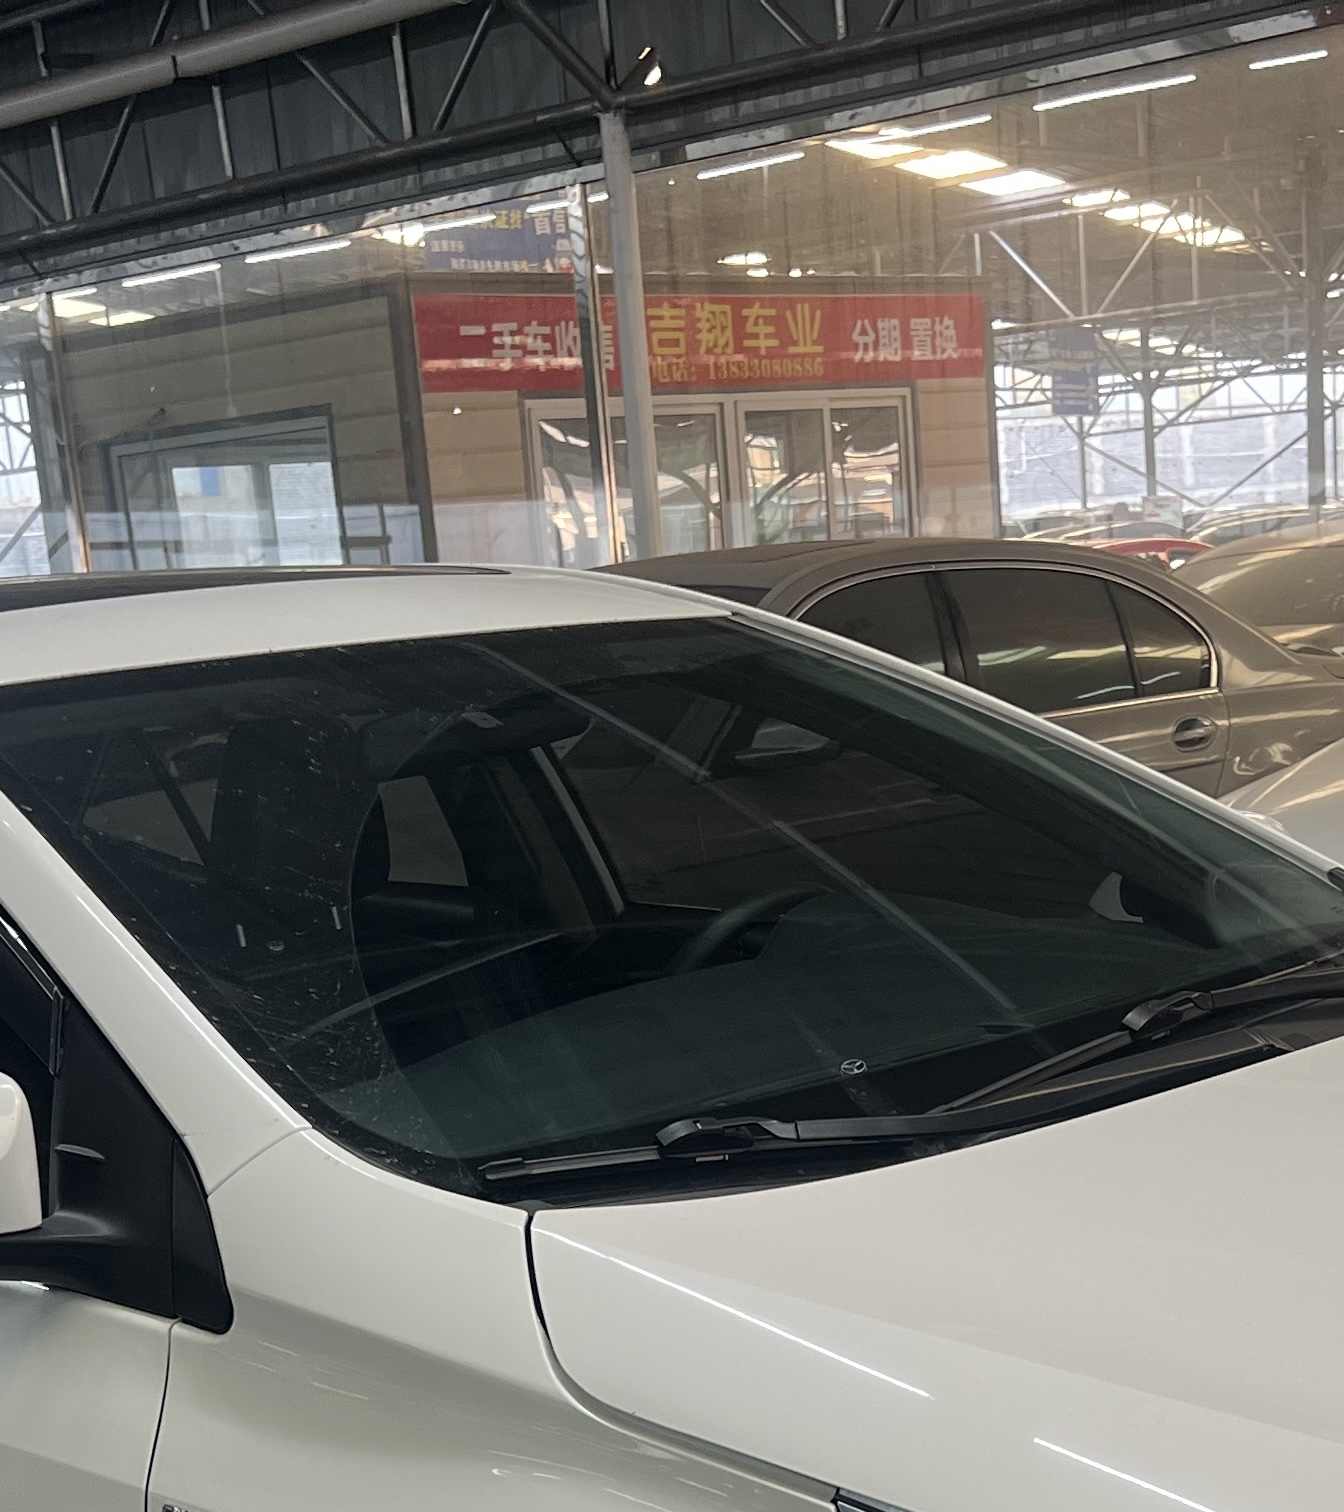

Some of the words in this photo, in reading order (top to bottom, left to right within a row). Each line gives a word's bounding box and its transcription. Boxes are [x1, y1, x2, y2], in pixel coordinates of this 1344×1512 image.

[646, 303, 825, 356] 吉翔车业
[851, 318, 902, 363] 分期
[909, 316, 959, 362] 置换
